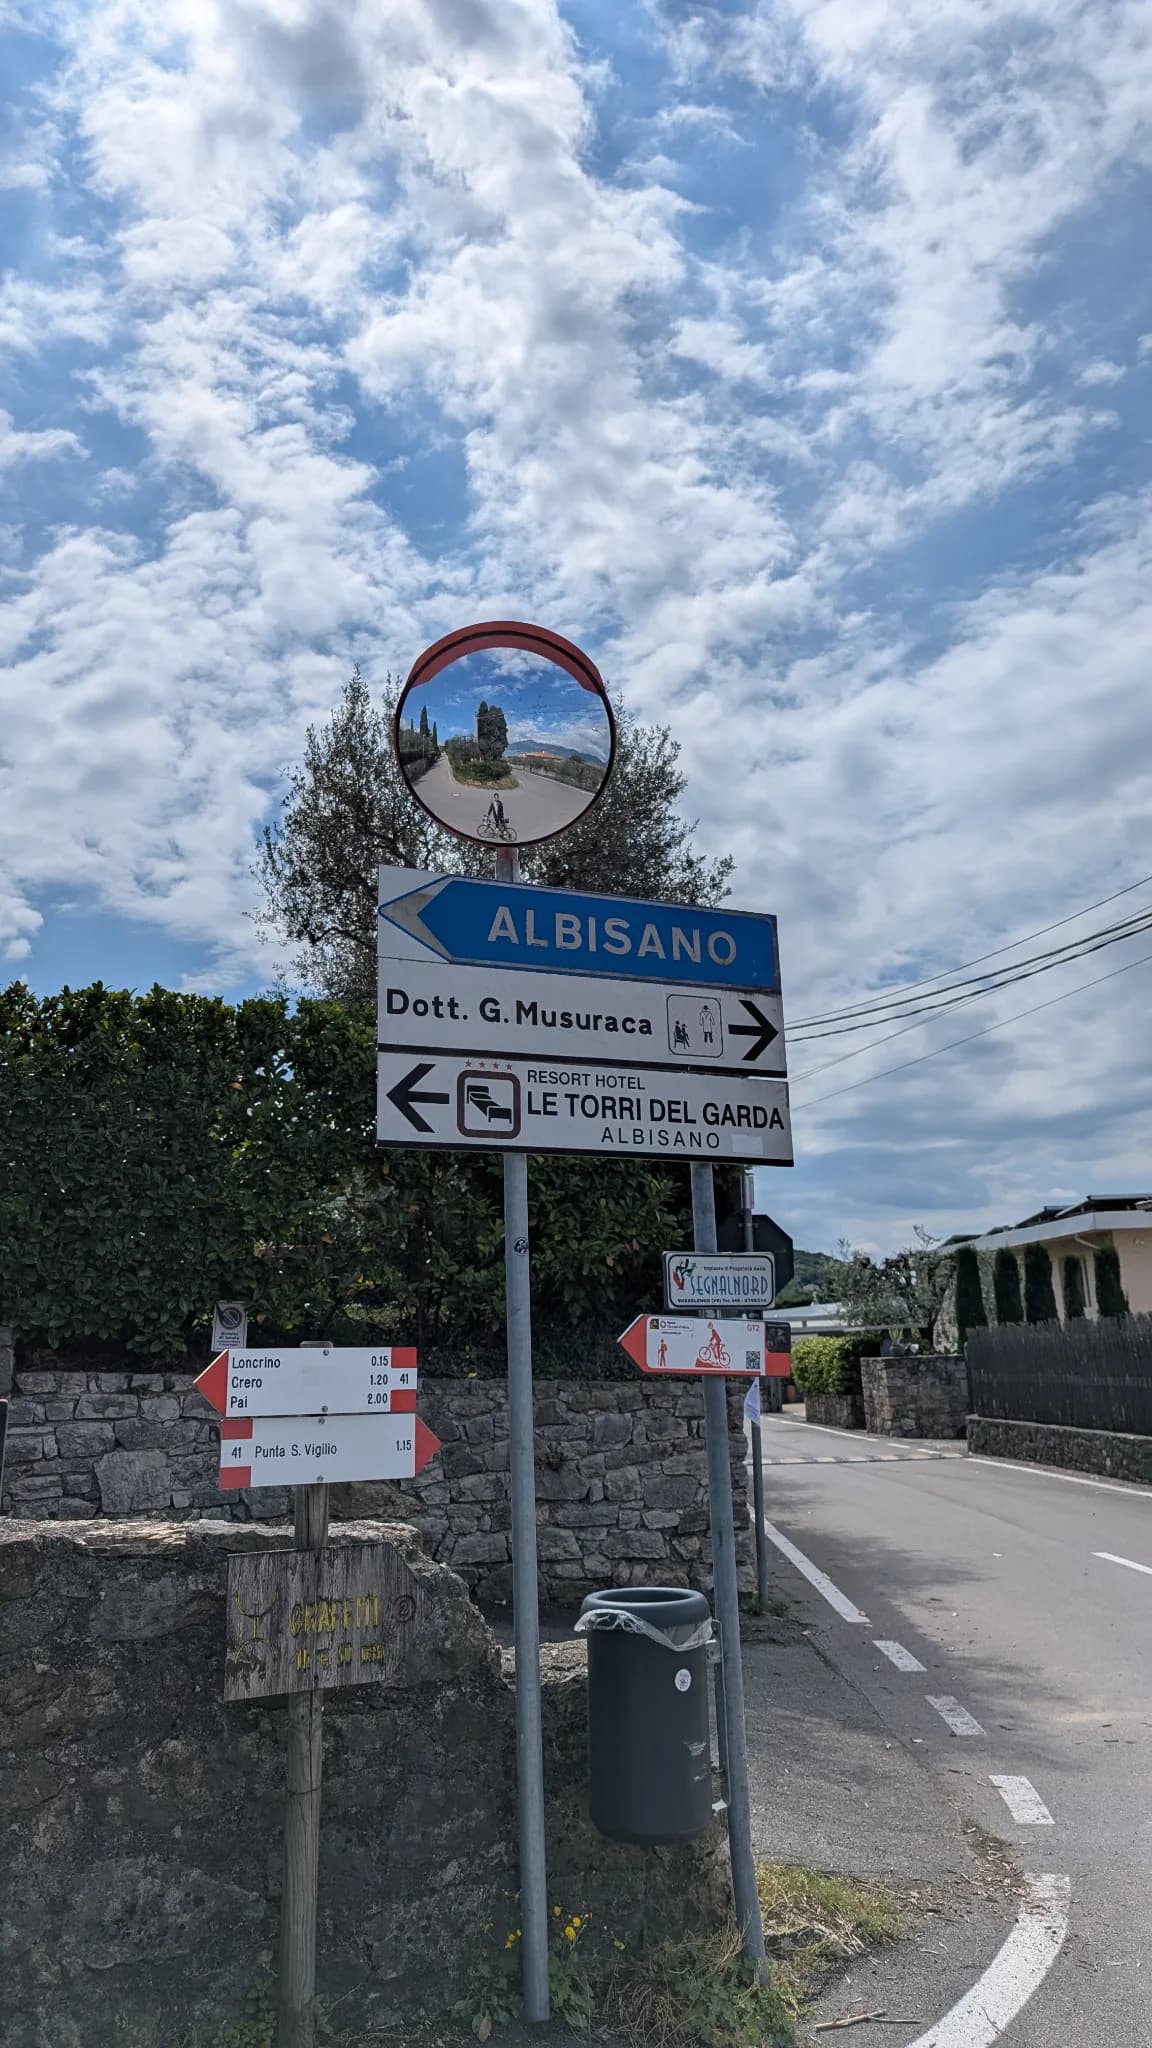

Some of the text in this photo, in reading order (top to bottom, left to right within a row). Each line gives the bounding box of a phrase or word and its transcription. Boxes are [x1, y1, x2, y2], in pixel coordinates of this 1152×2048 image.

[487, 906, 737, 966] ALBISANO
[386, 988, 468, 1021] Dott.
[528, 1070, 645, 1090] RESORT HOTEL
[527, 1091, 784, 1130] LE TORRI DEL GARDA
[601, 1127, 720, 1148] ALBISANO
[691, 1276, 768, 1295] SEGNALNORD
[232, 1356, 388, 1369] Loncrino 0.15
[231, 1375, 388, 1388] Crero 1.20
[400, 1374, 409, 1384] 41
[231, 1393, 388, 1408] Pai 2.00
[231, 1447, 242, 1458] 41
[255, 1440, 411, 1457] Punta S. Vigilio 1.15
